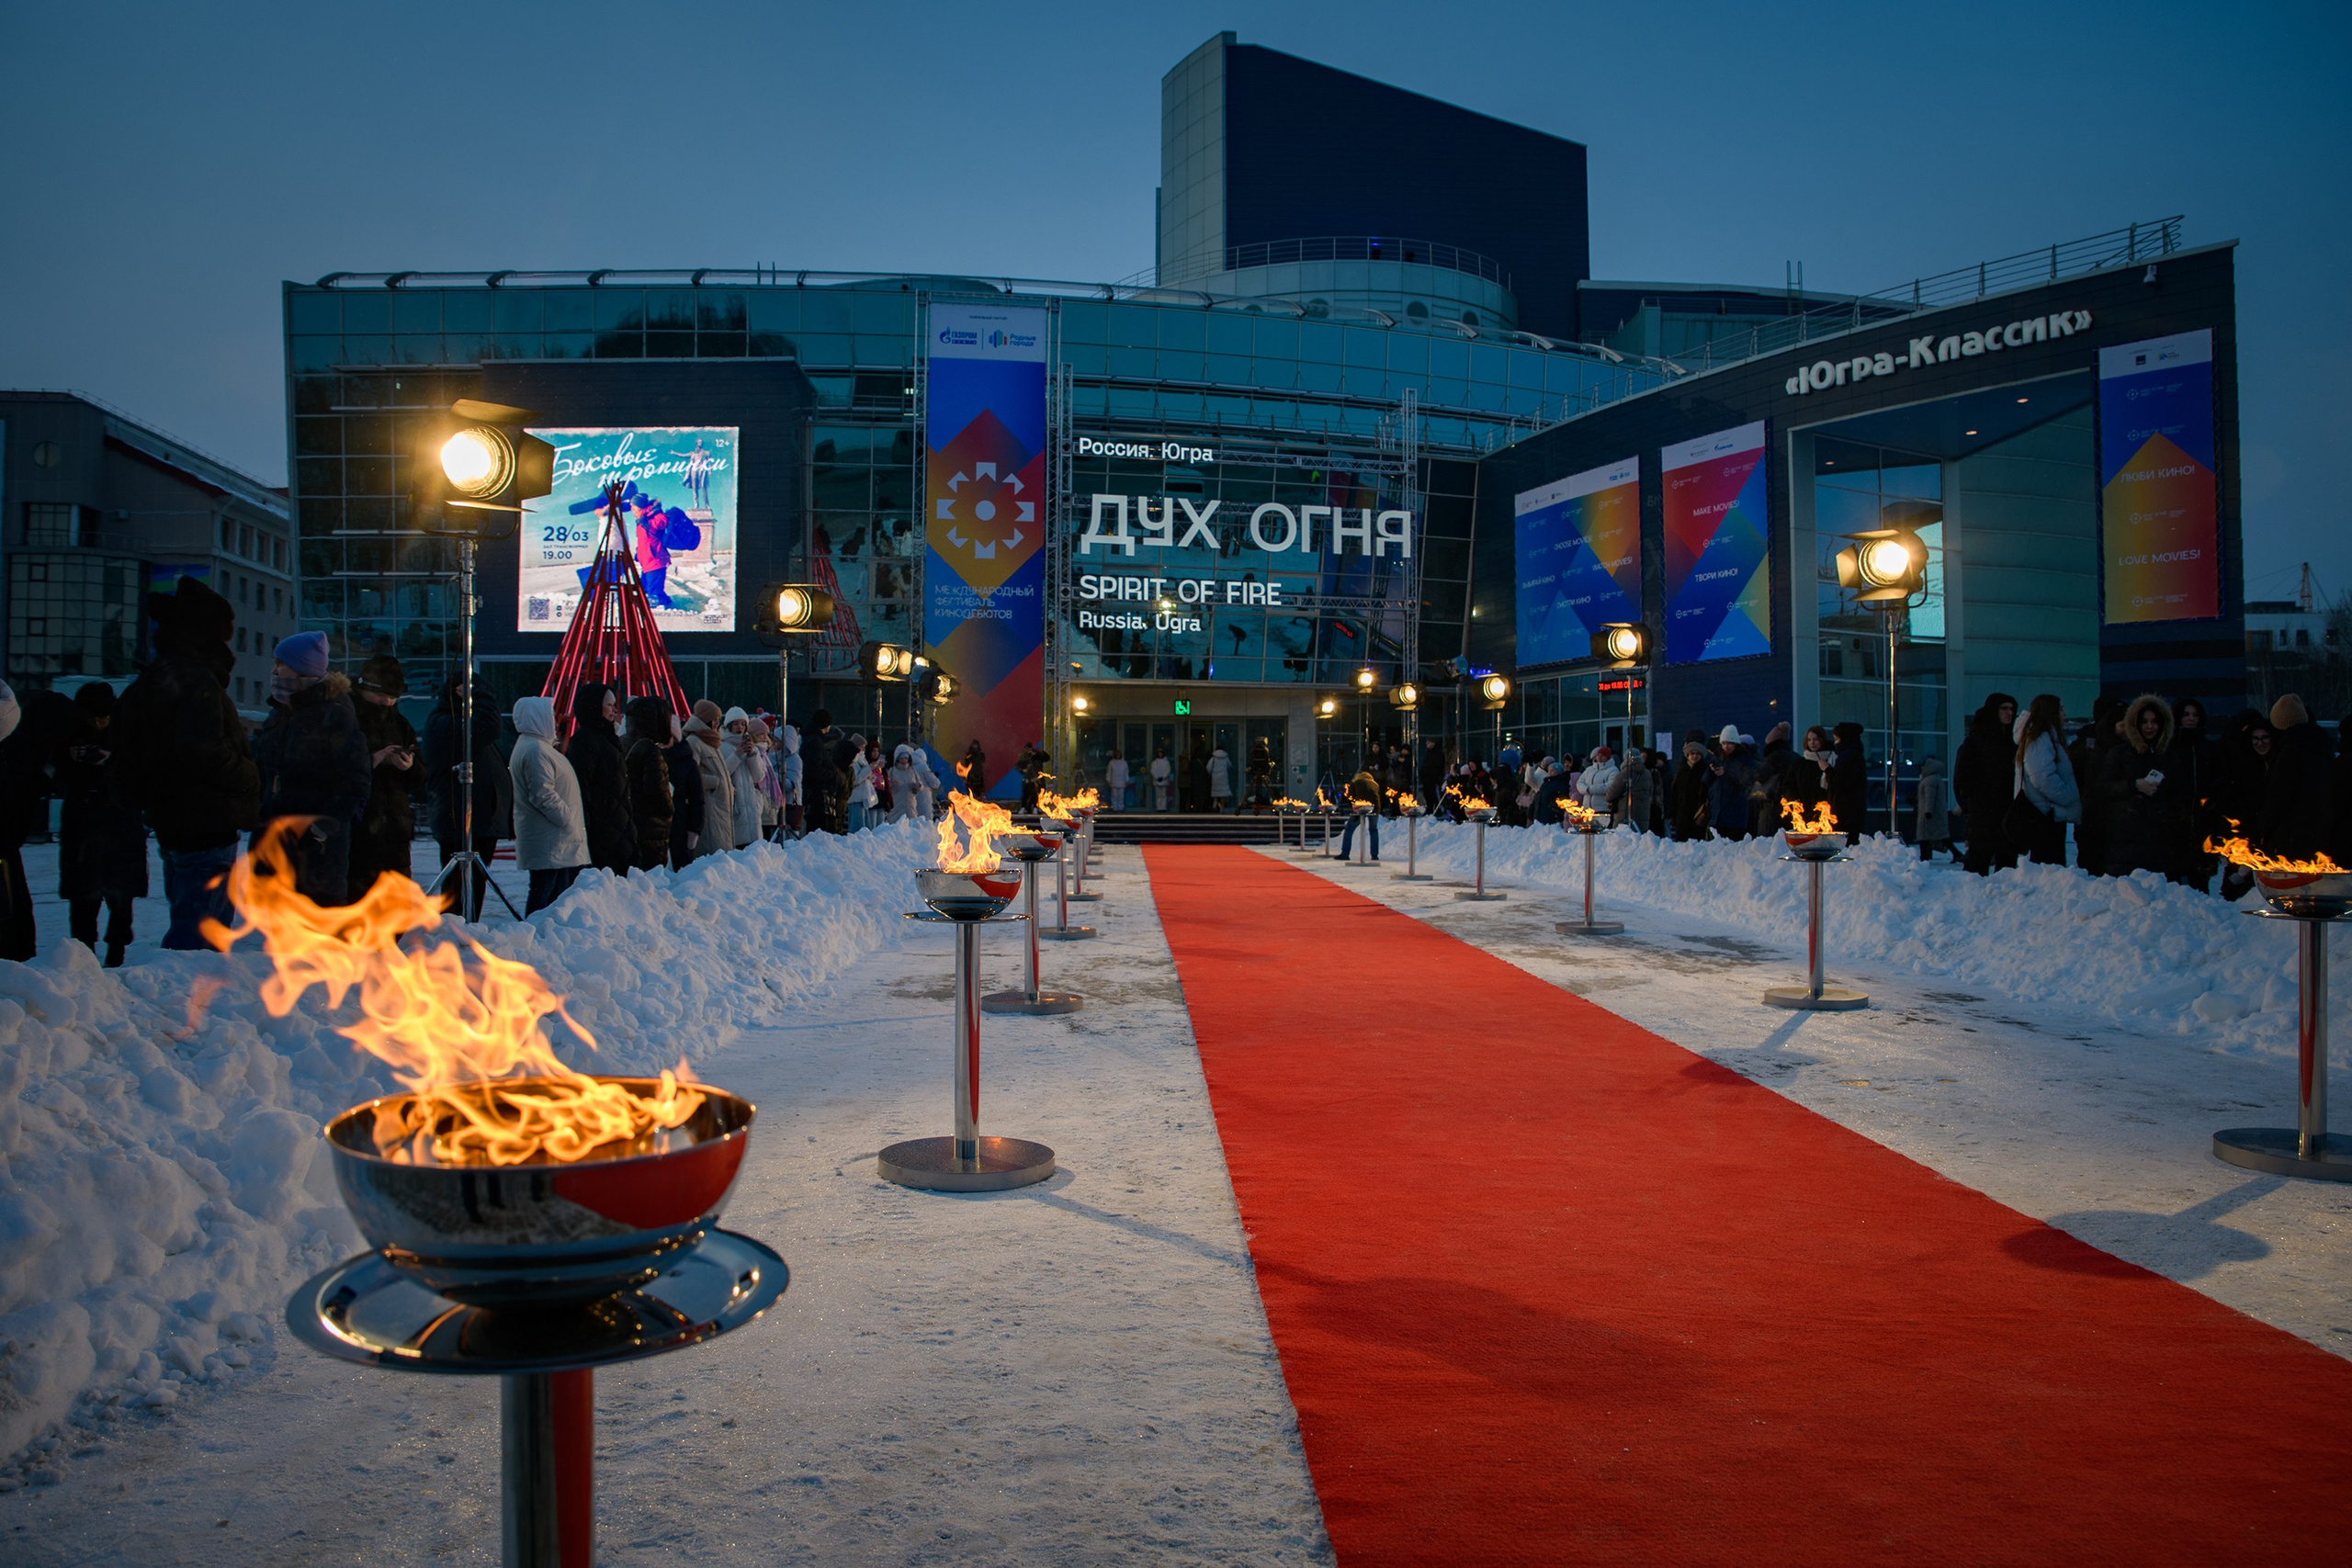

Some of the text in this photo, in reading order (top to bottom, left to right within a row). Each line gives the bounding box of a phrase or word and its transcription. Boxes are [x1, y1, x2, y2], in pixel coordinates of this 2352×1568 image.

[1010, 333, 1036, 342] Родные
[1785, 310, 2092, 395] «Югра-Классик»
[716, 439, 730, 447] 12+
[552, 432, 658, 486] Боковые
[1162, 442, 1214, 464] Югра
[597, 457, 729, 497] тропинки
[2120, 465, 2195, 483] ЛЮБИ КИНО!
[1692, 500, 1741, 516] MAKE MOVIES!
[1080, 493, 1411, 558] ДУХ ОГНЯ
[543, 551, 572, 559] 19.00
[2118, 549, 2200, 566] LOVE MOVIES!
[1695, 568, 1738, 582] ТВОРИ КИНО!
[934, 584, 1035, 597] МЕЖДУНАРОДНЫЙ
[1079, 574, 1283, 606] SPIRIT OF FIRE
[935, 597, 996, 607] ФЕСТИВАЛЬ
[934, 608, 1012, 620] КИНОДЕБЮТОВ
[1156, 613, 1202, 634] Ugra
